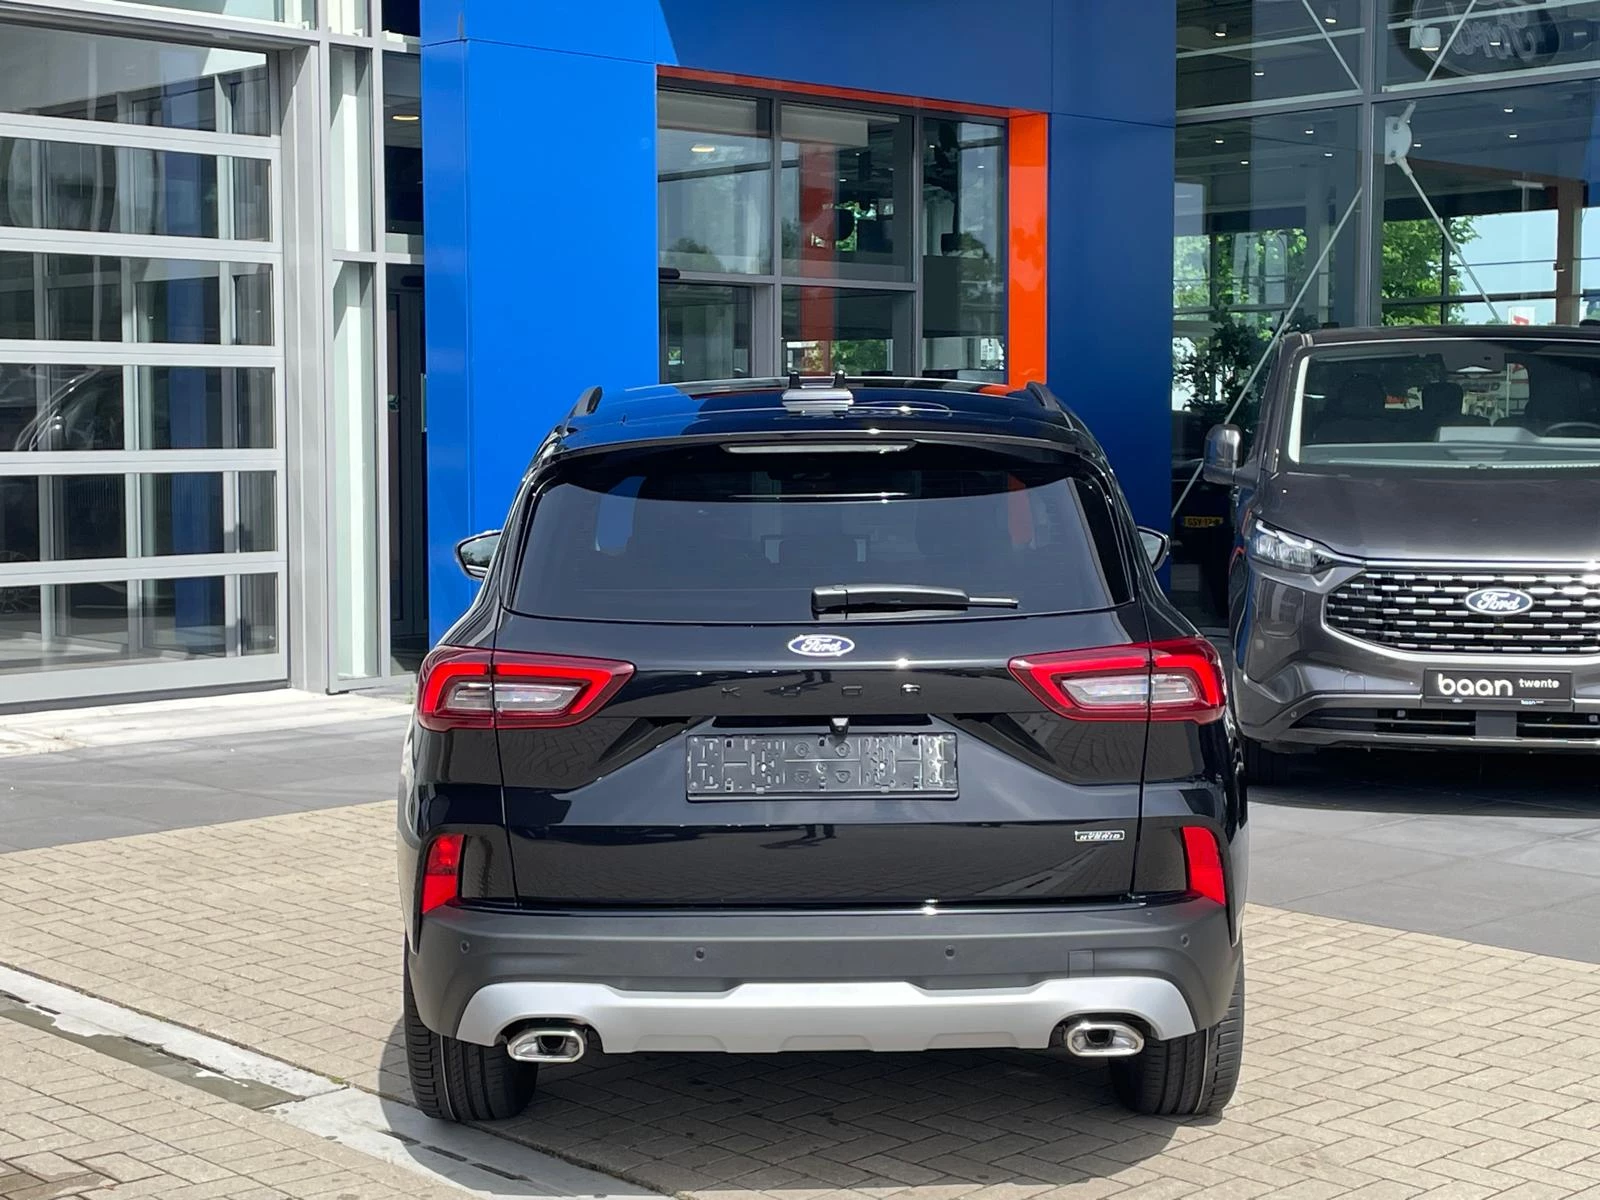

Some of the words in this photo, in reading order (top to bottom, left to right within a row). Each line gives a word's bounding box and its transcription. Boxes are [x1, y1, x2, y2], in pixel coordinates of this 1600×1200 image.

[1476, 592, 1520, 610] Ford
[800, 638, 842, 652] Ford
[1438, 673, 1513, 696] baan
[1519, 678, 1560, 689] twente
